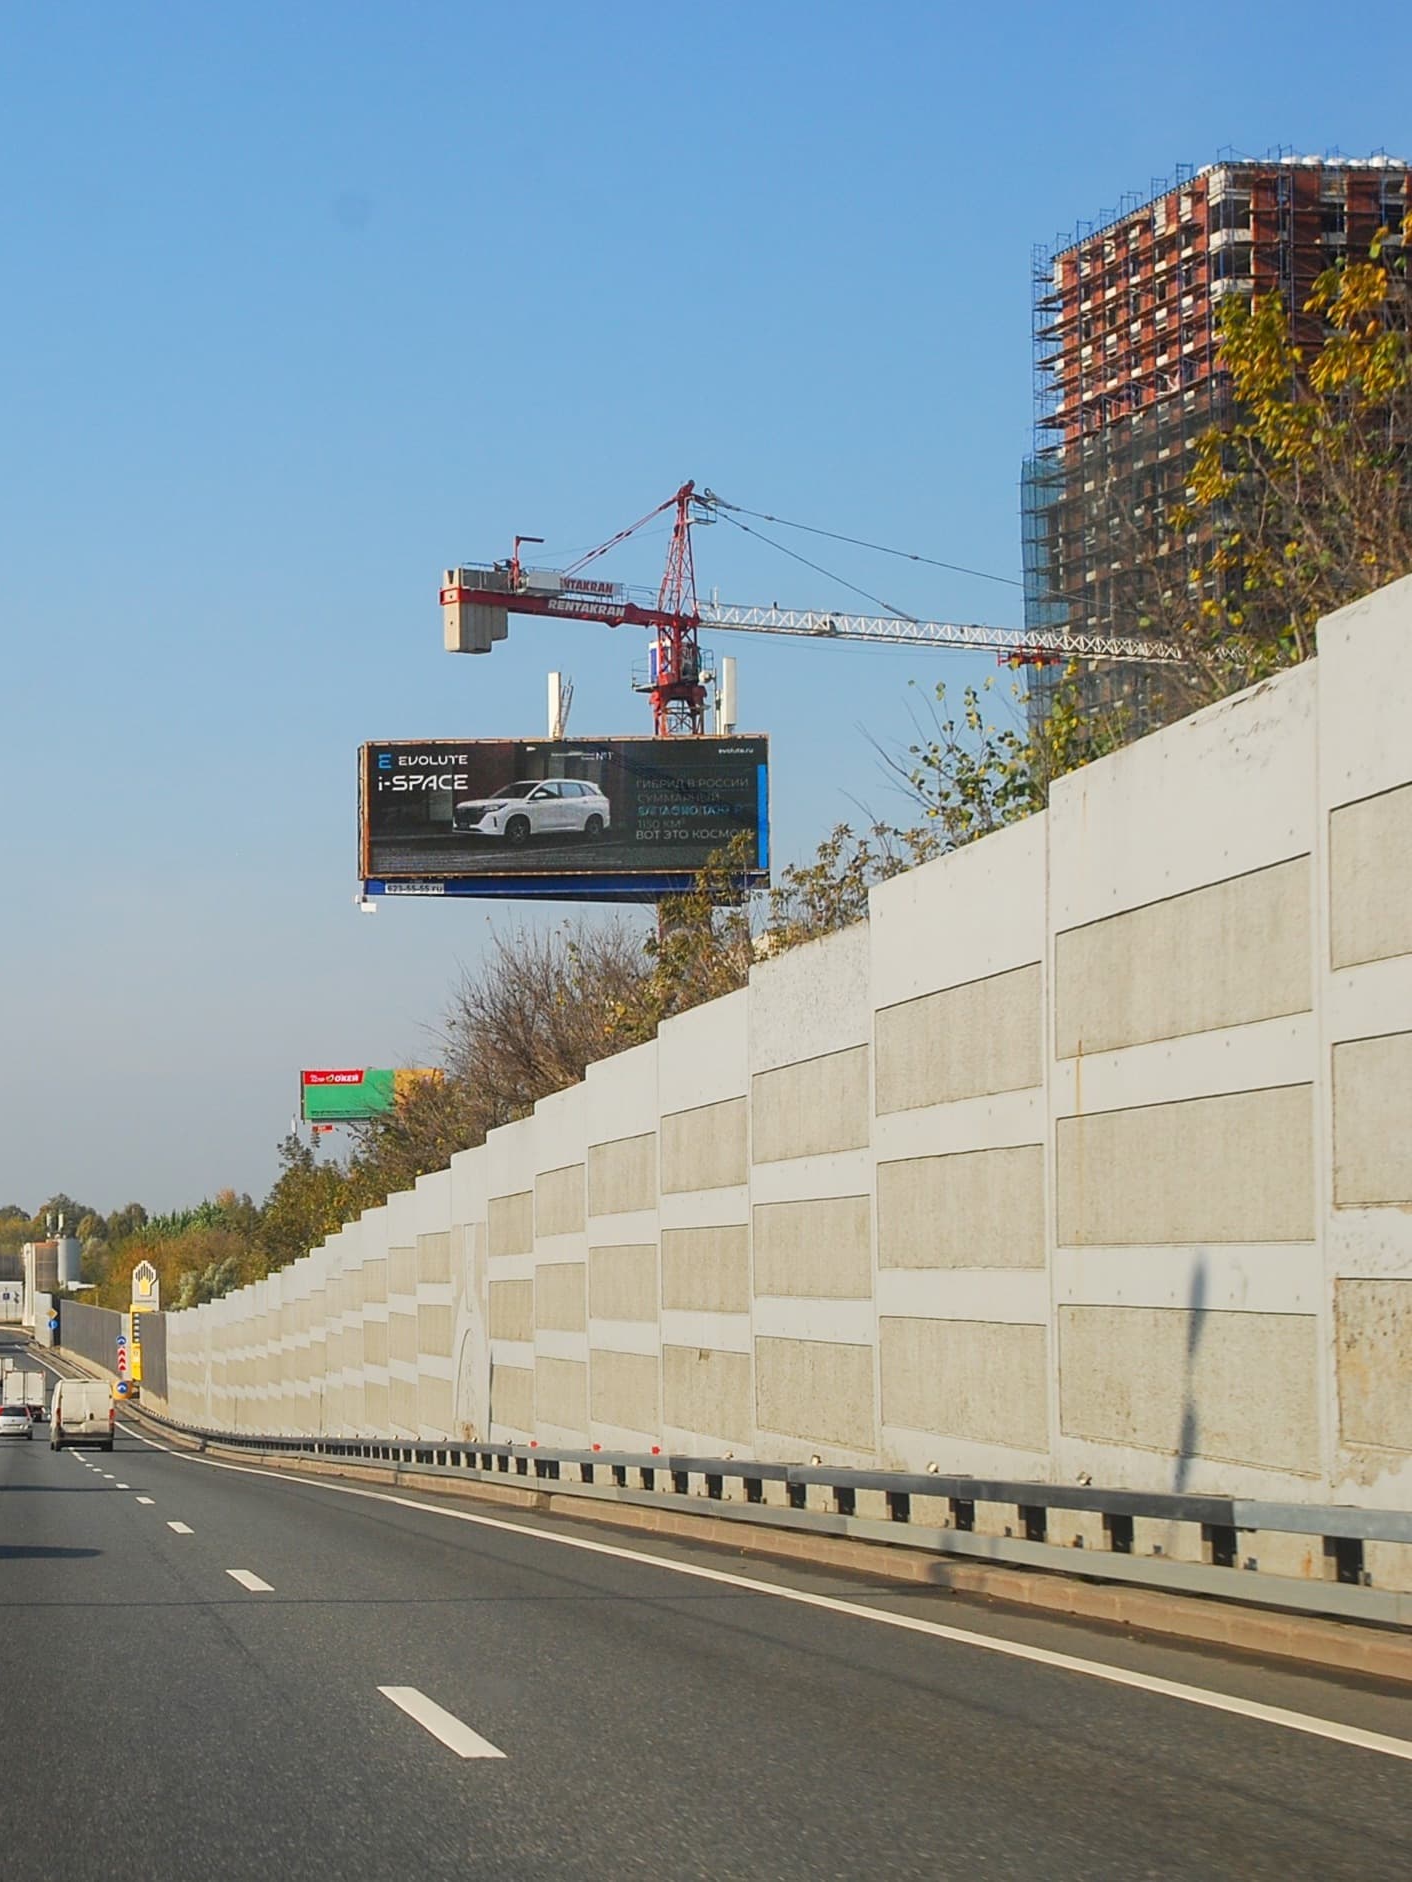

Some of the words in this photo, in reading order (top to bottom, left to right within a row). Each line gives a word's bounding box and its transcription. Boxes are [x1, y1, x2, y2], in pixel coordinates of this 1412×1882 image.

[548, 599, 625, 617] RENTAKRAN
[398, 754, 468, 766] EVOLUTE
[378, 774, 469, 791] i-SPACE
[698, 777, 749, 788] РОССИИ
[636, 830, 661, 840] ВОТ
[664, 829, 689, 840] ЭТО
